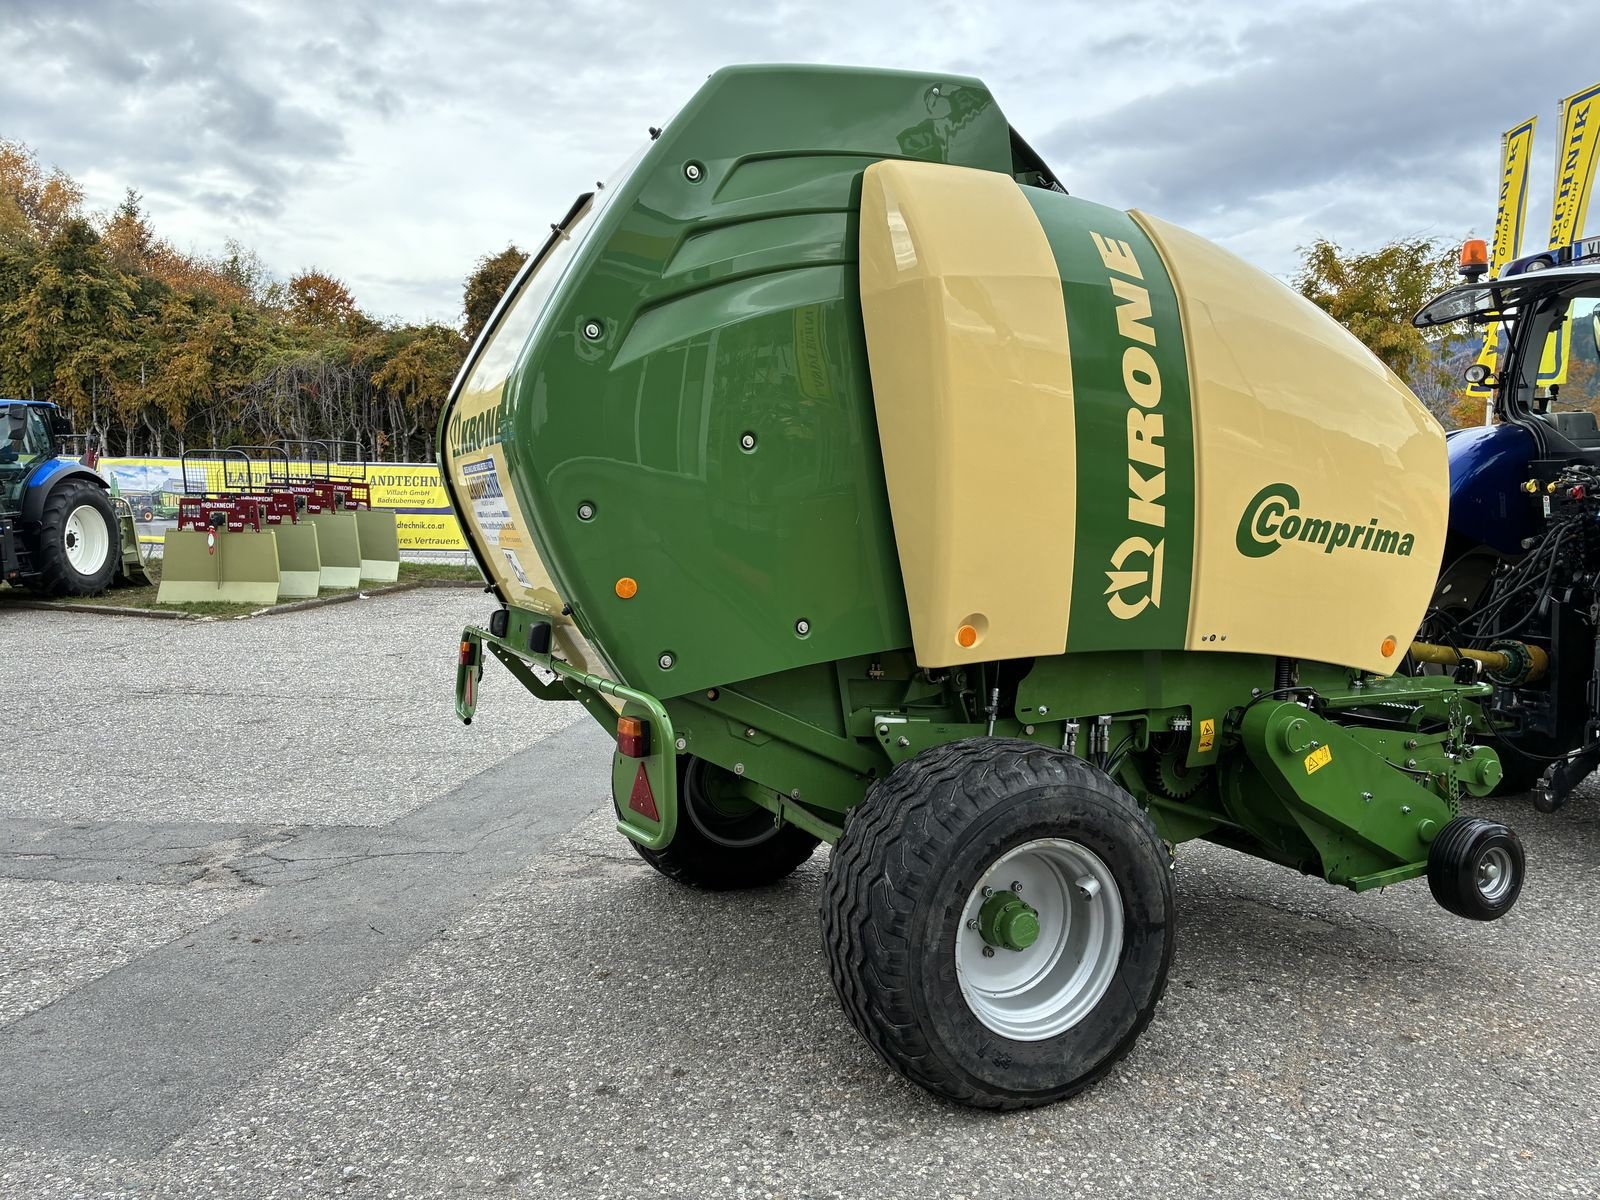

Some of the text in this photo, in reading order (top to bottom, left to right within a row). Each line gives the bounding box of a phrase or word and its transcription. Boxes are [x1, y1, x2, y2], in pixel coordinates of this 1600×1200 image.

[1563, 182, 1579, 229] GmbH
[1089, 230, 1166, 528] KRONE
[377, 497, 426, 505] Badstubenweg
[415, 537, 460, 545] Vertrauens
